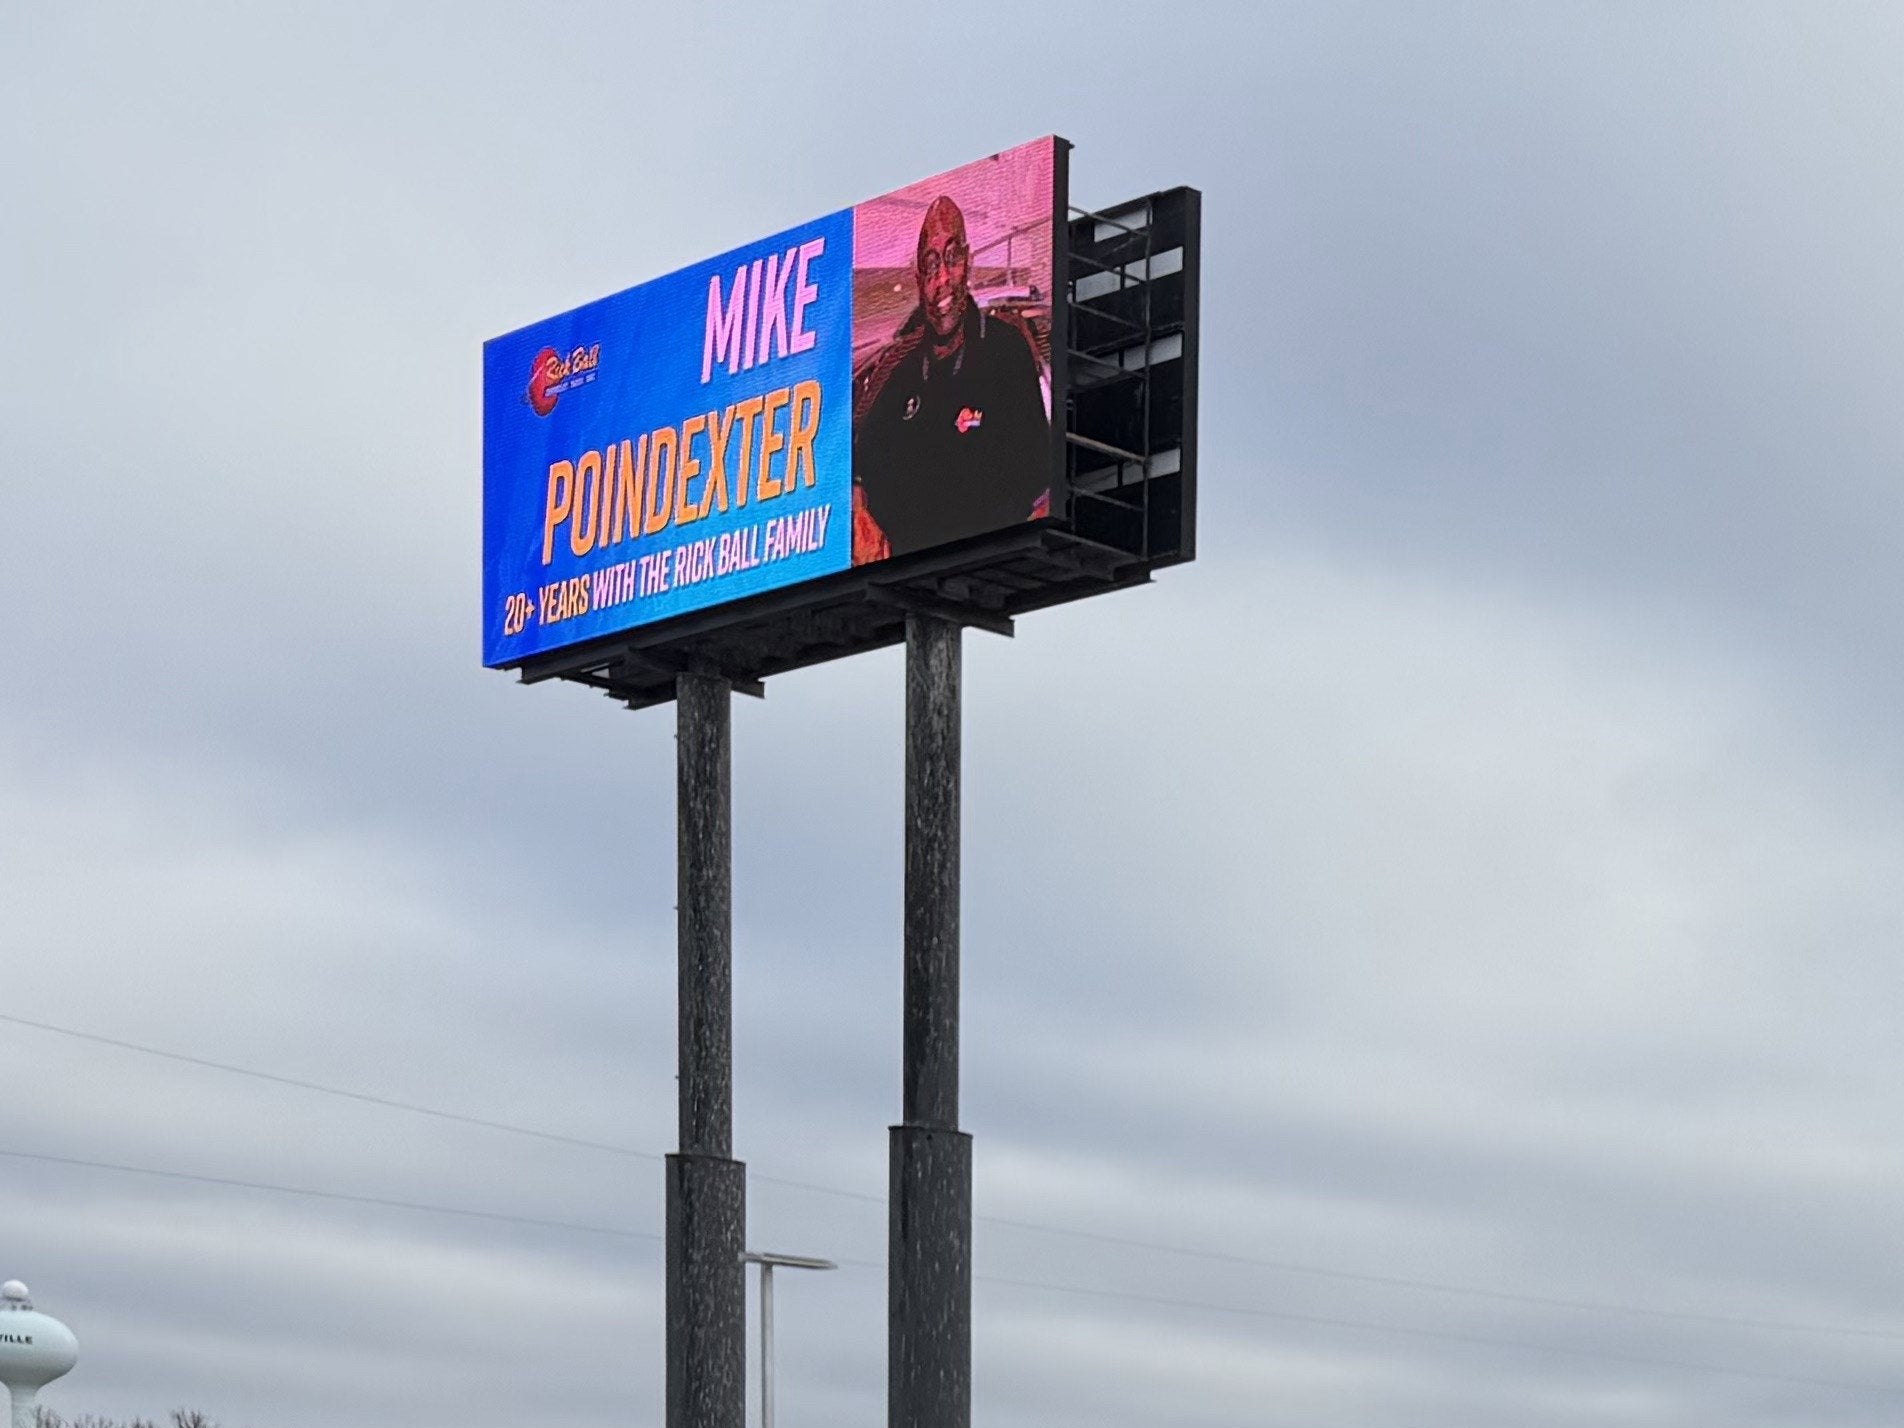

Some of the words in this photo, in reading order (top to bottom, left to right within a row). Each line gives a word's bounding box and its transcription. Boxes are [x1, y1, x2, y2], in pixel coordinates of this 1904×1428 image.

[571, 344, 600, 374] Ball
[702, 237, 825, 383] MIKE
[542, 379, 822, 565] POINDEXTER
[504, 592, 535, 636] 20+
[538, 573, 590, 626] YEARS
[592, 559, 635, 610] WITH
[639, 549, 669, 597] THE
[671, 537, 716, 588] RICK
[716, 525, 760, 576] BALL
[762, 504, 831, 563] FAMILY
